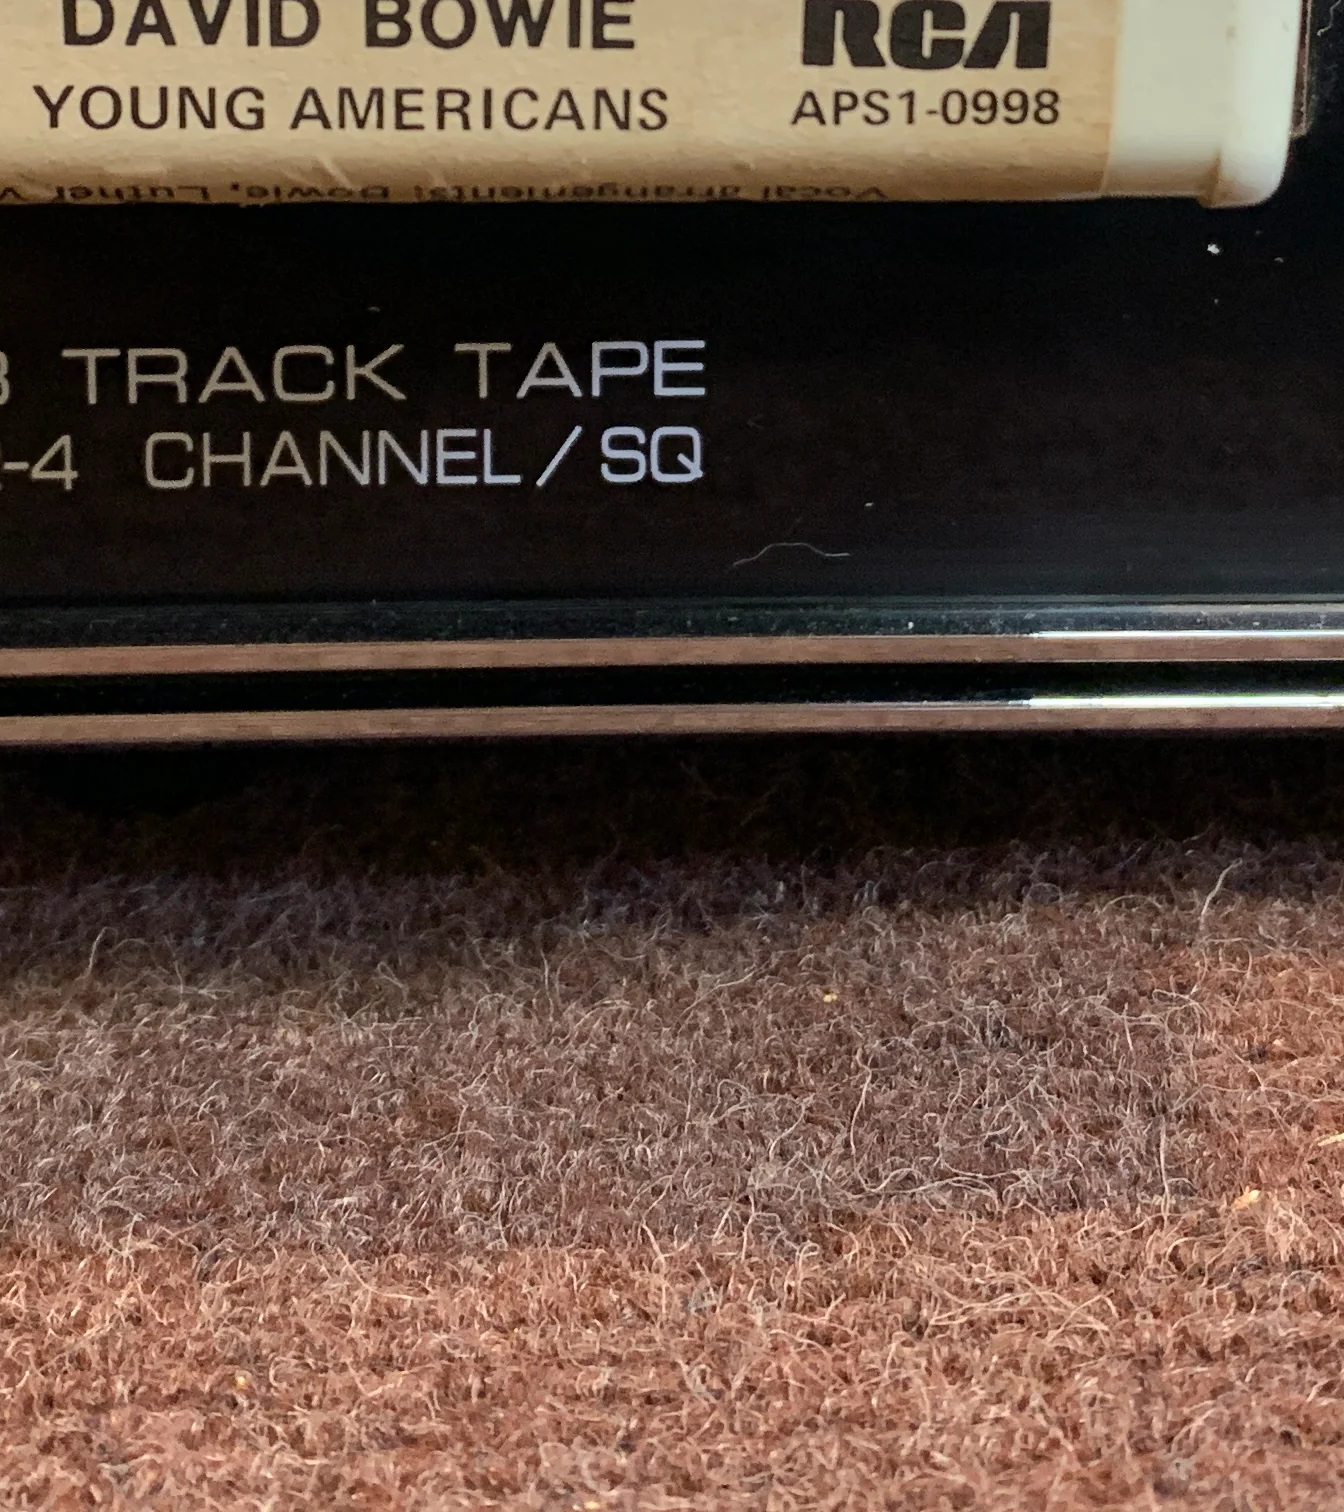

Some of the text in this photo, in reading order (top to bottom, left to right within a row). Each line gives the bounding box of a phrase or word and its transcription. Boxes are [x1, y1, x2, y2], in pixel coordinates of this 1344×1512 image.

[32, 84, 669, 132] YOUNG AMERICANS
[791, 88, 1060, 127] APS1-0998
[61, 343, 408, 406] TRACK
[454, 338, 707, 400] TAPE
